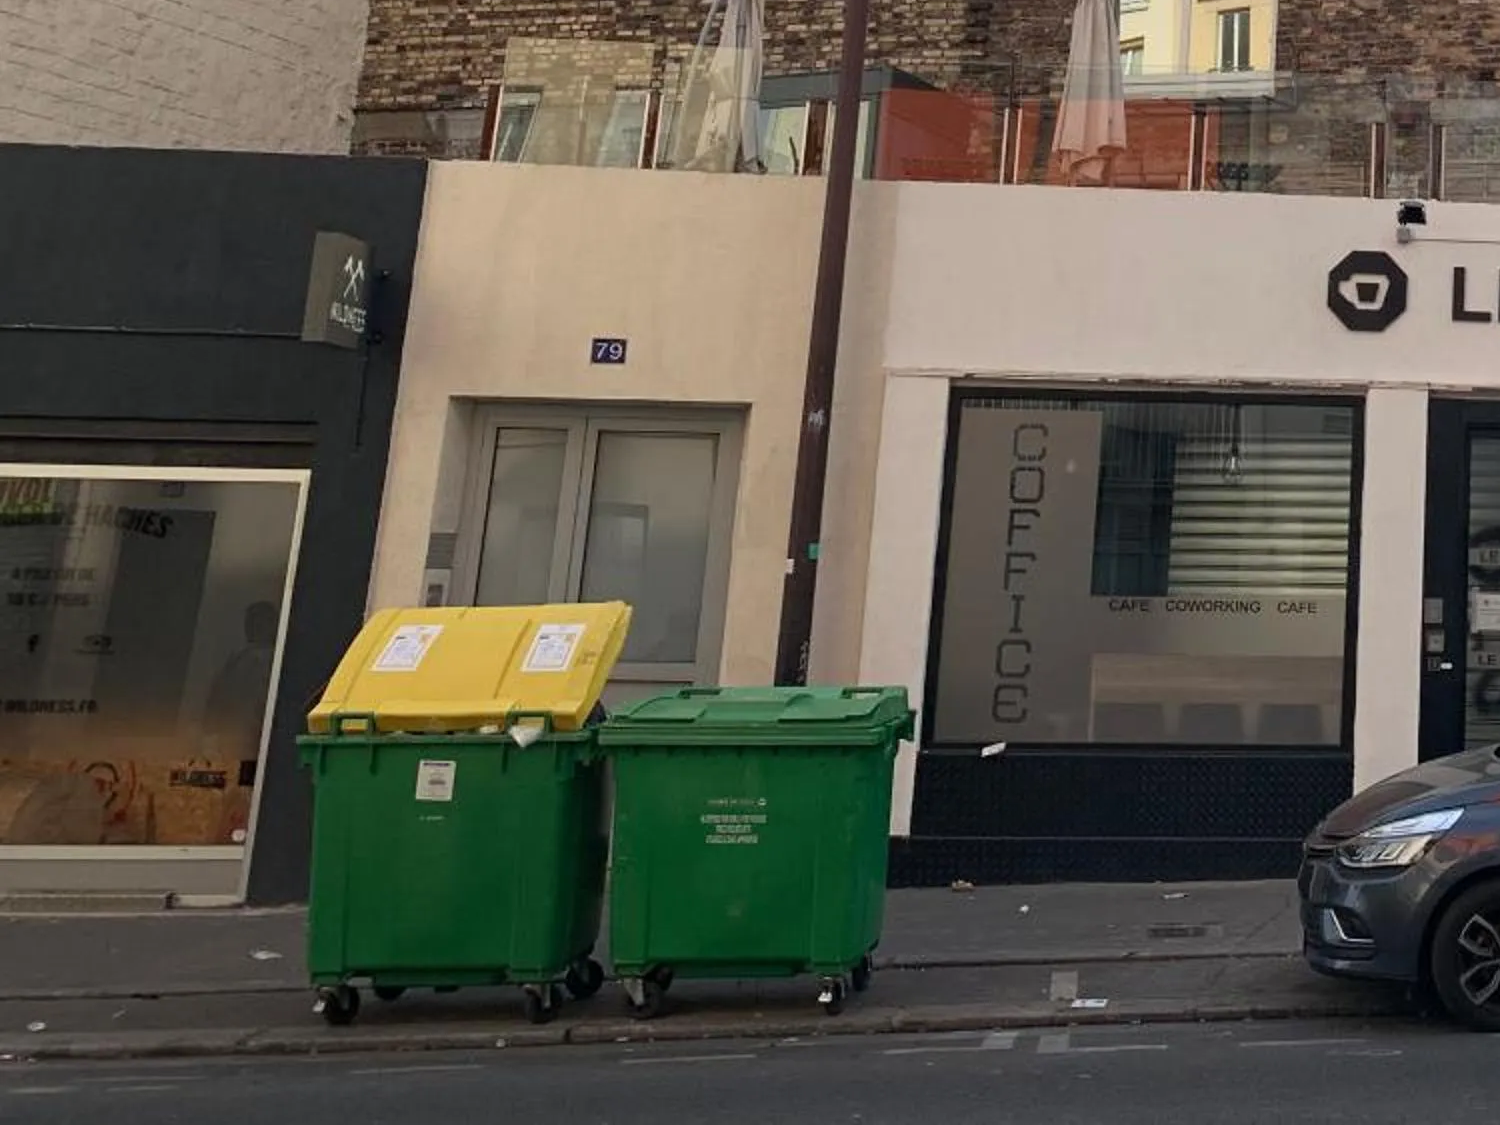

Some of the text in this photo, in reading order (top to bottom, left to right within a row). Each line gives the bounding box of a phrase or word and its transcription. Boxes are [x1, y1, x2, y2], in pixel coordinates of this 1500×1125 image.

[595, 342, 623, 360] 79
[1480, 551, 1499, 564] LE
[991, 424, 1049, 724] COFFICE
[1109, 599, 1318, 614] CAFE COWORKING CAFE
[1478, 655, 1497, 667] LE
